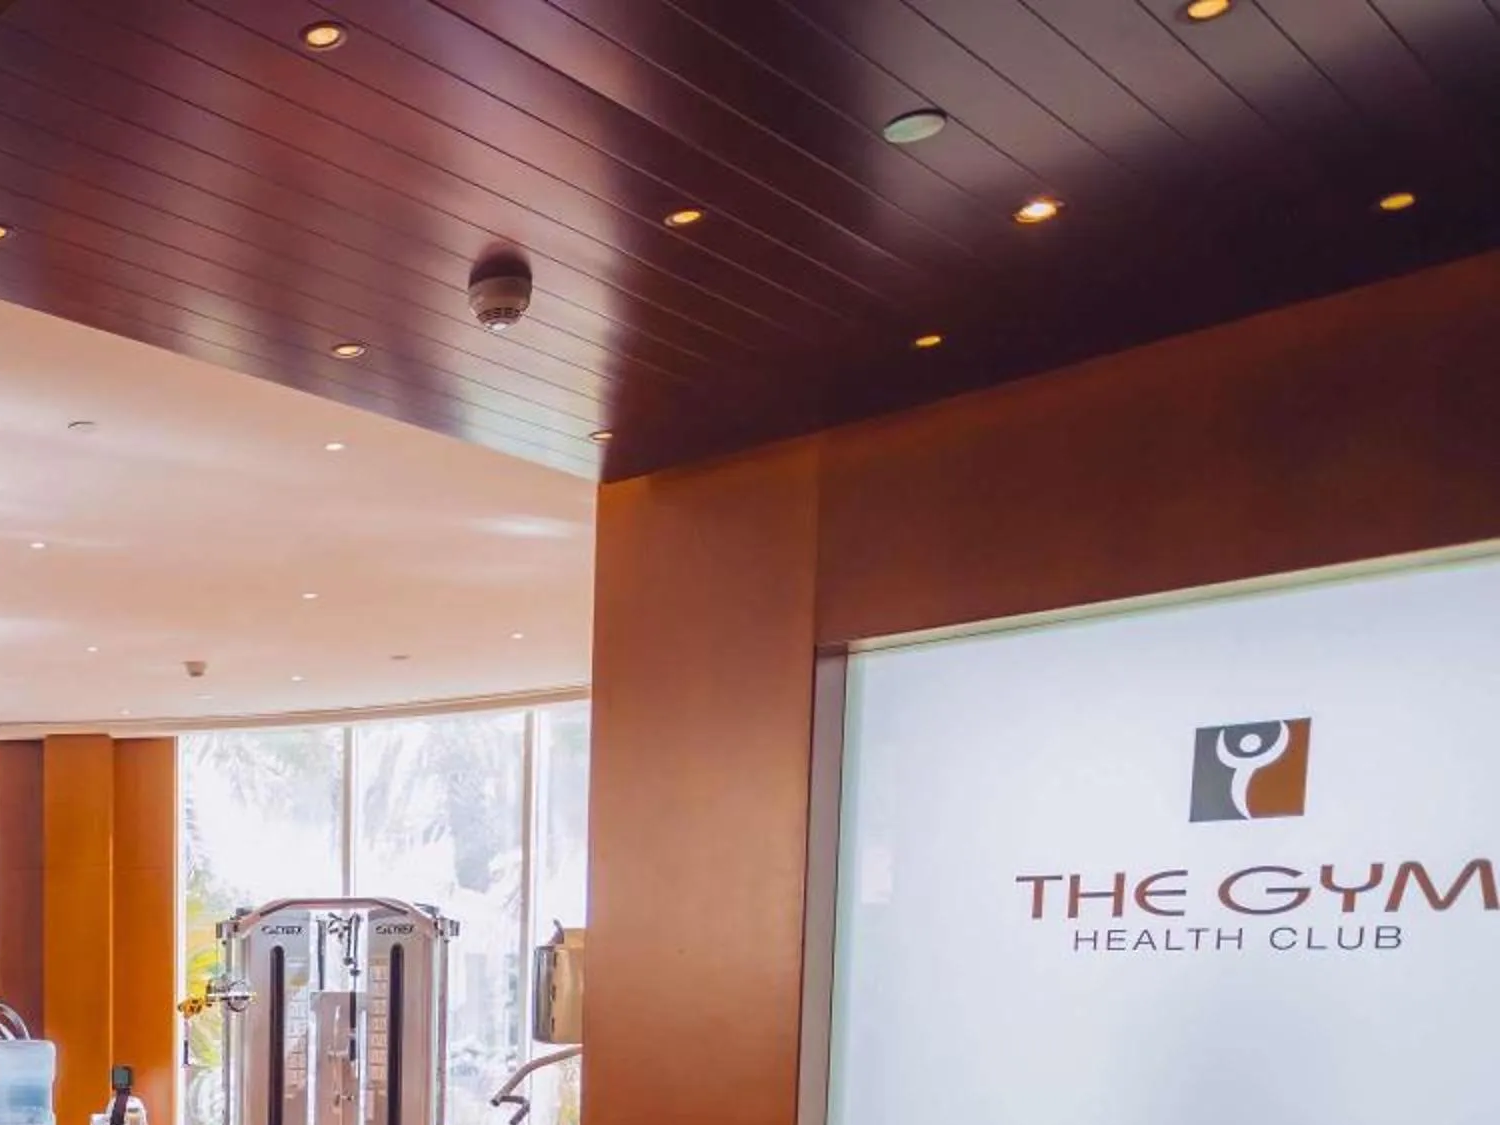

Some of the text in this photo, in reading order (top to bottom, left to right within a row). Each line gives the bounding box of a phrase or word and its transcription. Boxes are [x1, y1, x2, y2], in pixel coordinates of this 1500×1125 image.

[1015, 857, 1500, 919] THE GYM
[1072, 925, 1403, 951] HEALTH CLUB
